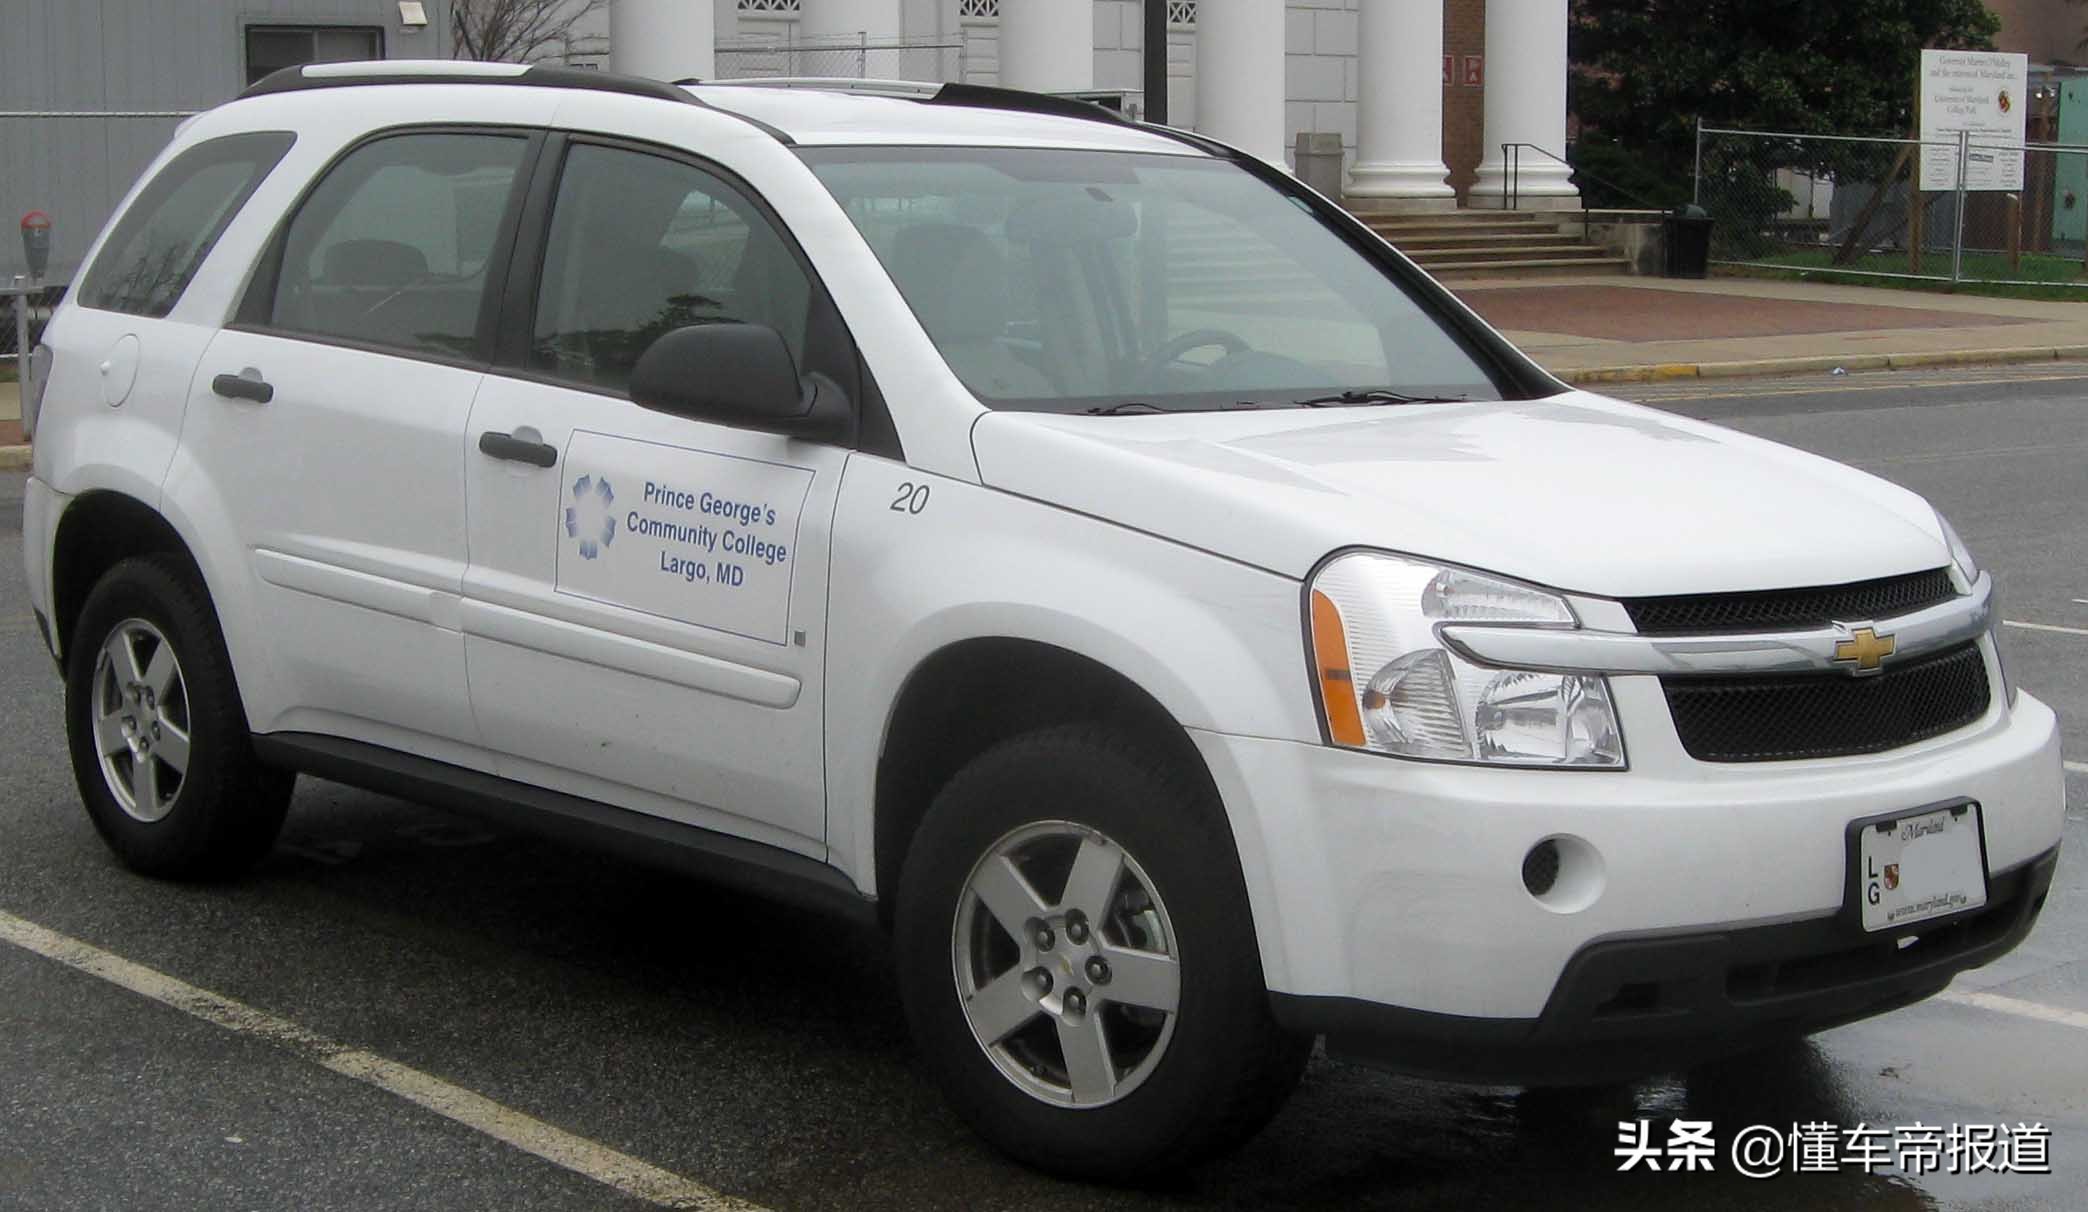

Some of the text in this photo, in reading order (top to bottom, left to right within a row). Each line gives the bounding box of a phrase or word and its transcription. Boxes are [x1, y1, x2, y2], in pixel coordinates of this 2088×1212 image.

[644, 482, 776, 526] Prince George's
[890, 482, 930, 514] 20
[627, 511, 787, 565] Community College
[660, 551, 744, 586] Largo, MD
